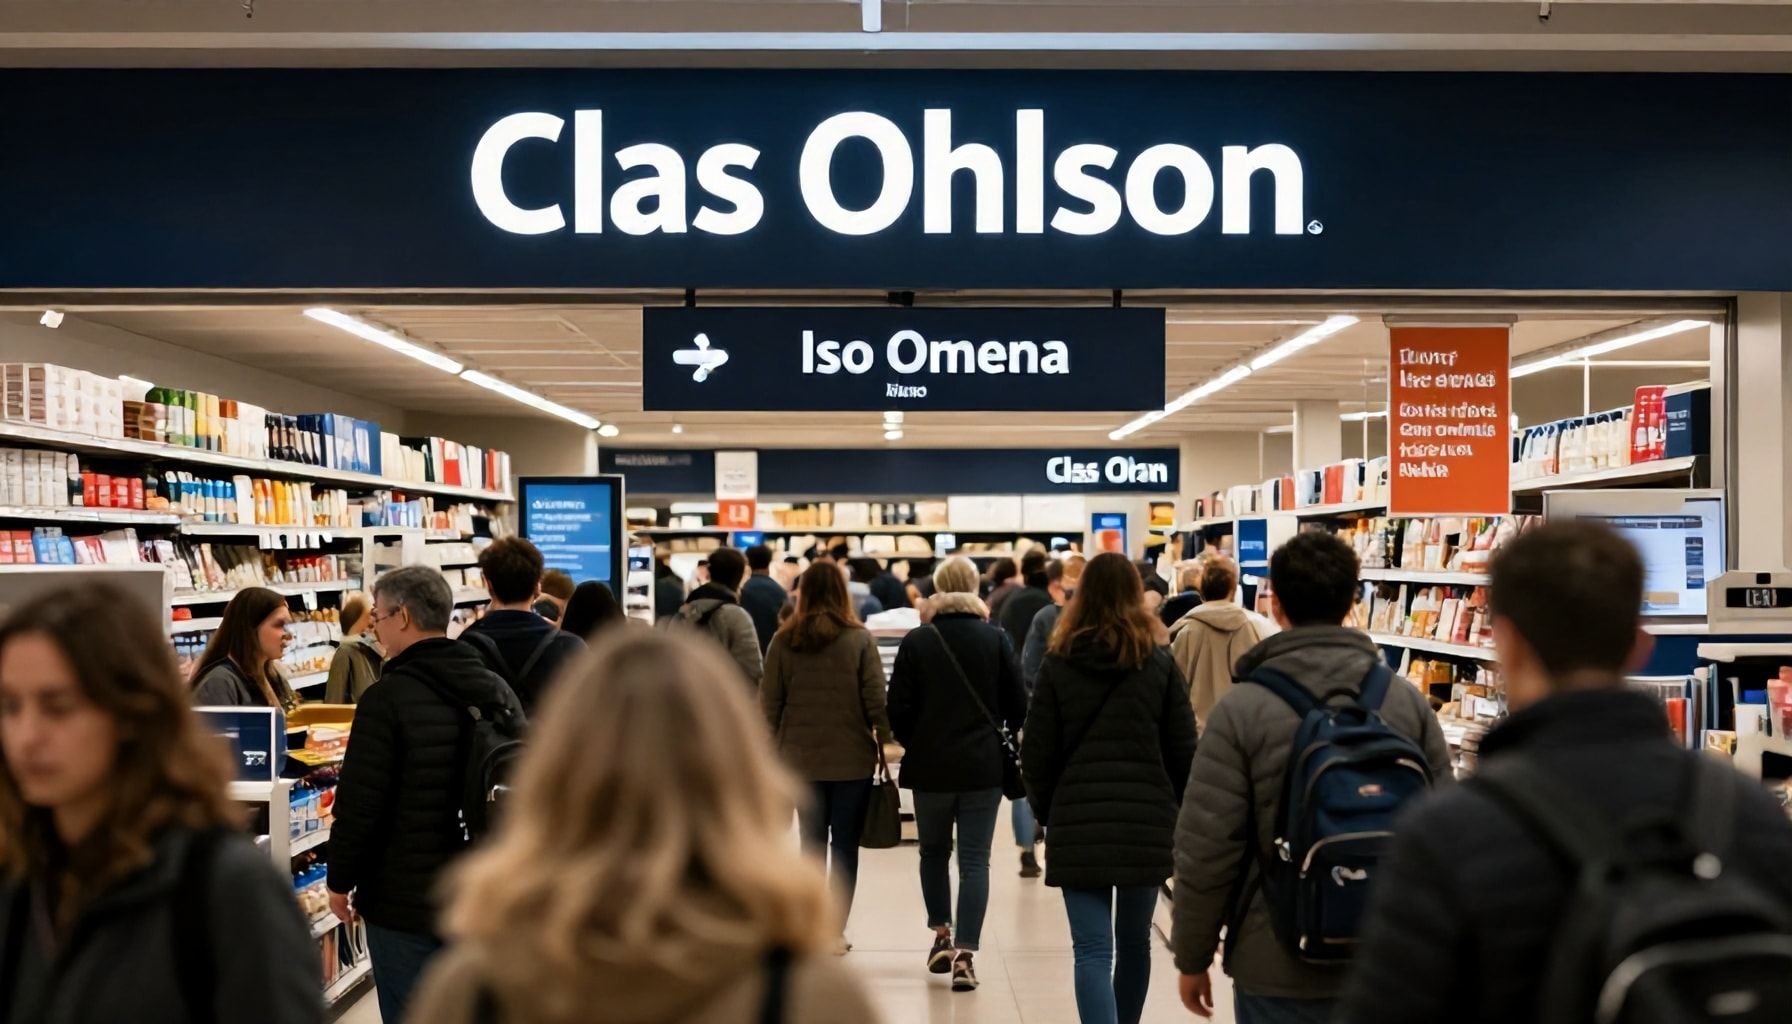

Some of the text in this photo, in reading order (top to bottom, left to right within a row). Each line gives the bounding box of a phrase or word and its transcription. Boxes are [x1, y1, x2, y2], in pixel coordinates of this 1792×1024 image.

[471, 109, 1303, 235] Clas Ohlson
[803, 330, 1069, 374] Iso Omena
